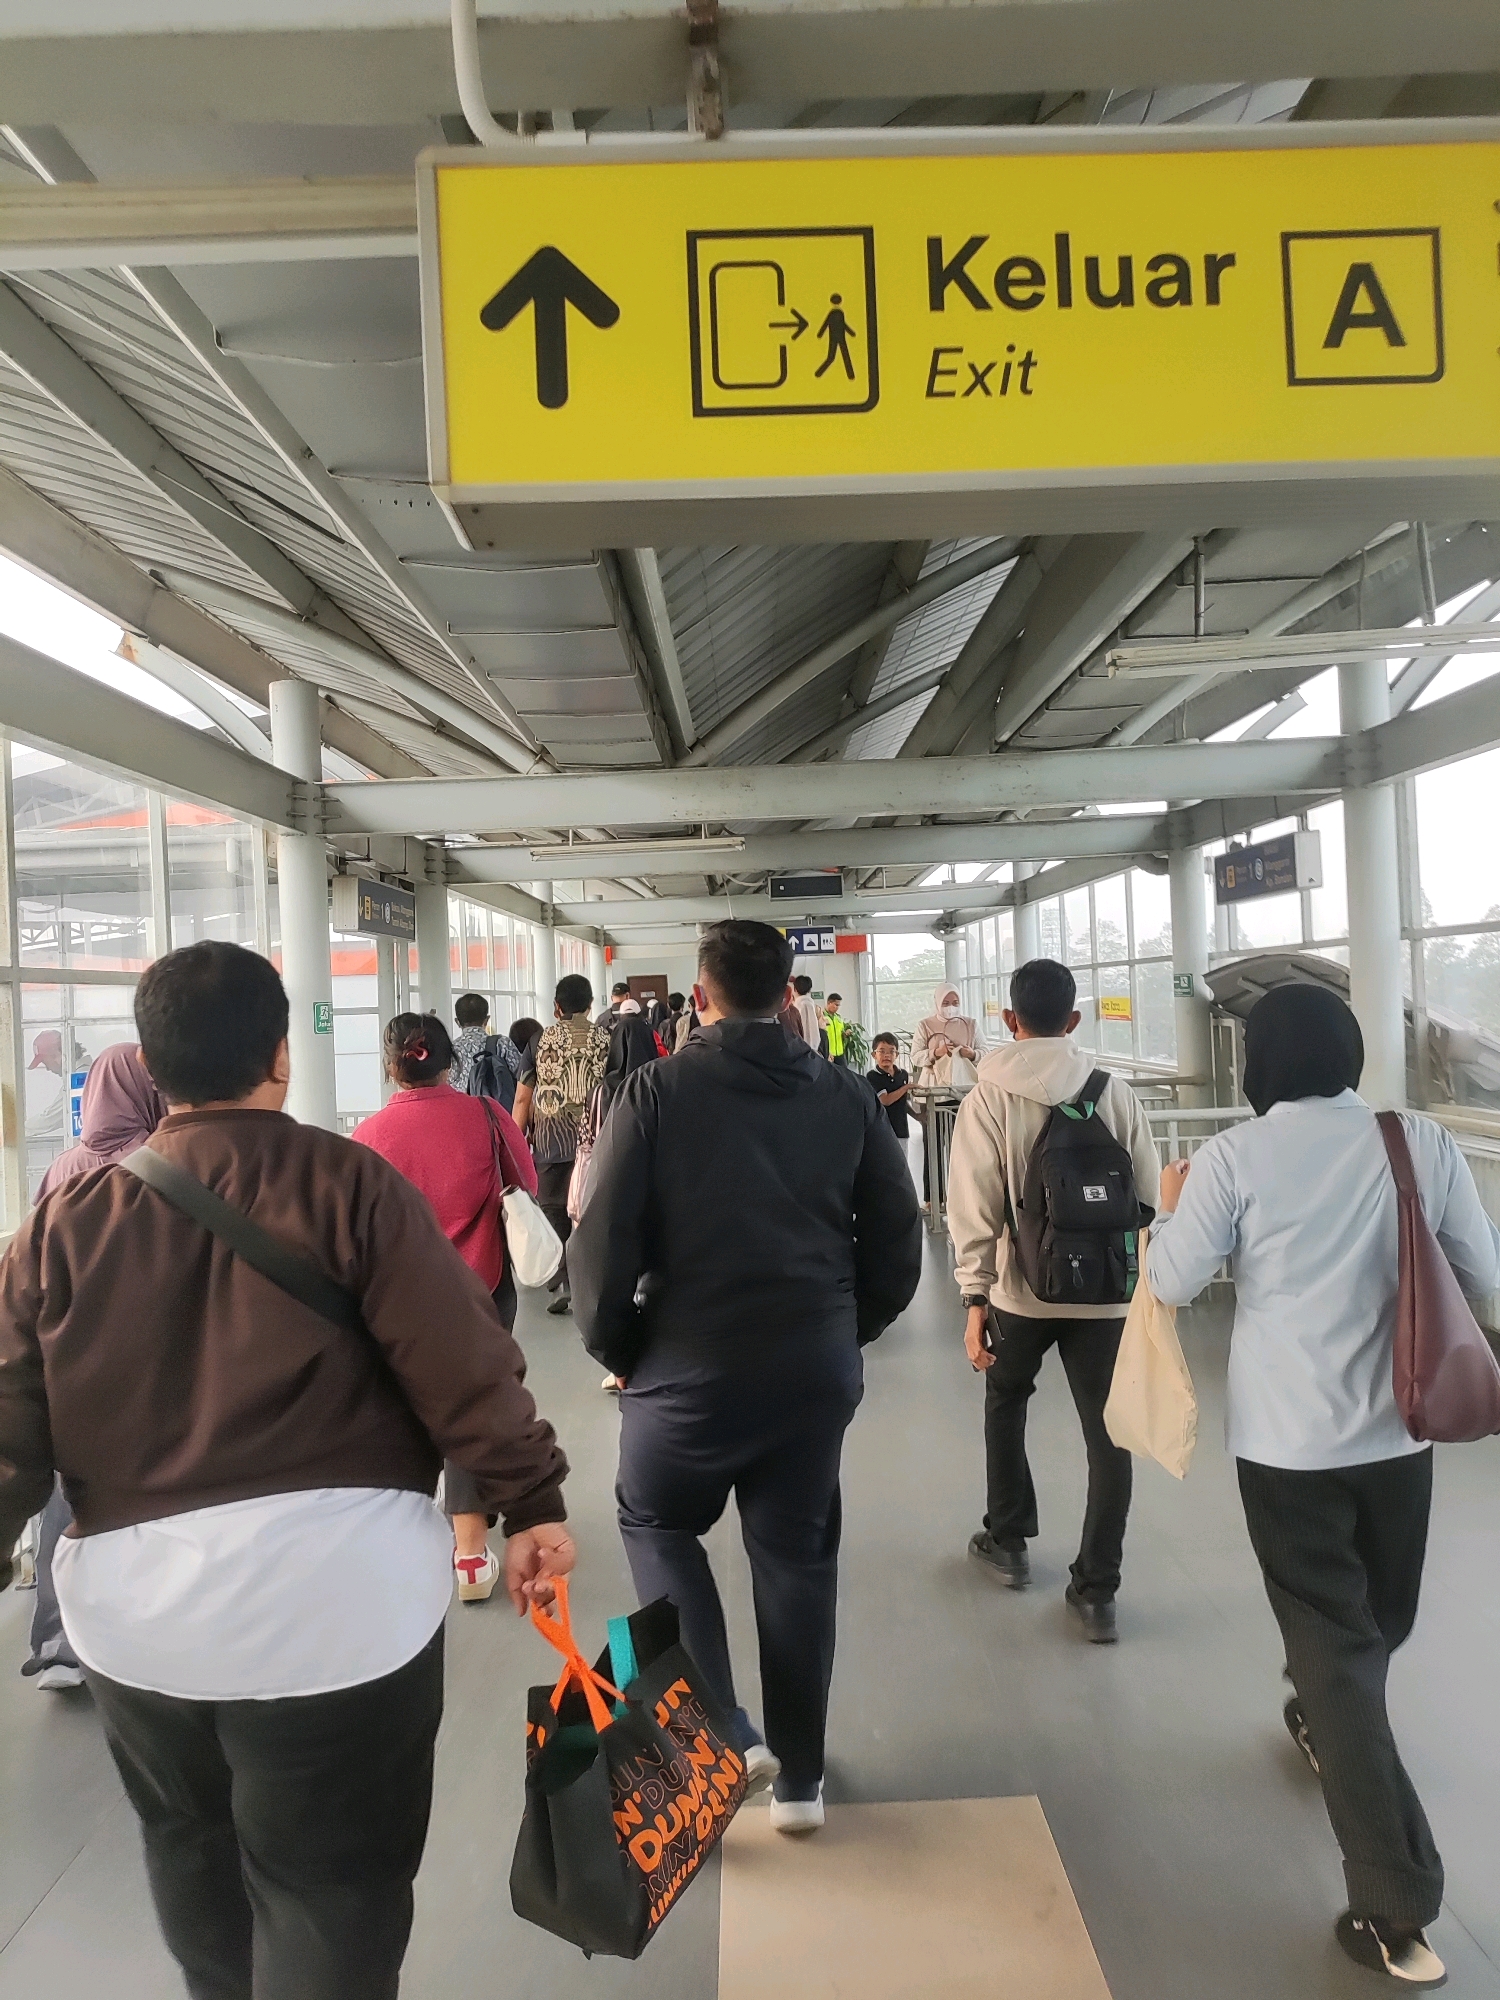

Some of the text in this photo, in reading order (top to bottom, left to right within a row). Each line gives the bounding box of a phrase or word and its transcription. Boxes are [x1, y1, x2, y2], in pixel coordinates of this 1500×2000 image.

[926, 231, 1237, 313] Keluar
[1322, 262, 1408, 349] A
[925, 343, 1038, 399] Exit
[648, 1844, 704, 1930] UNKIN'
